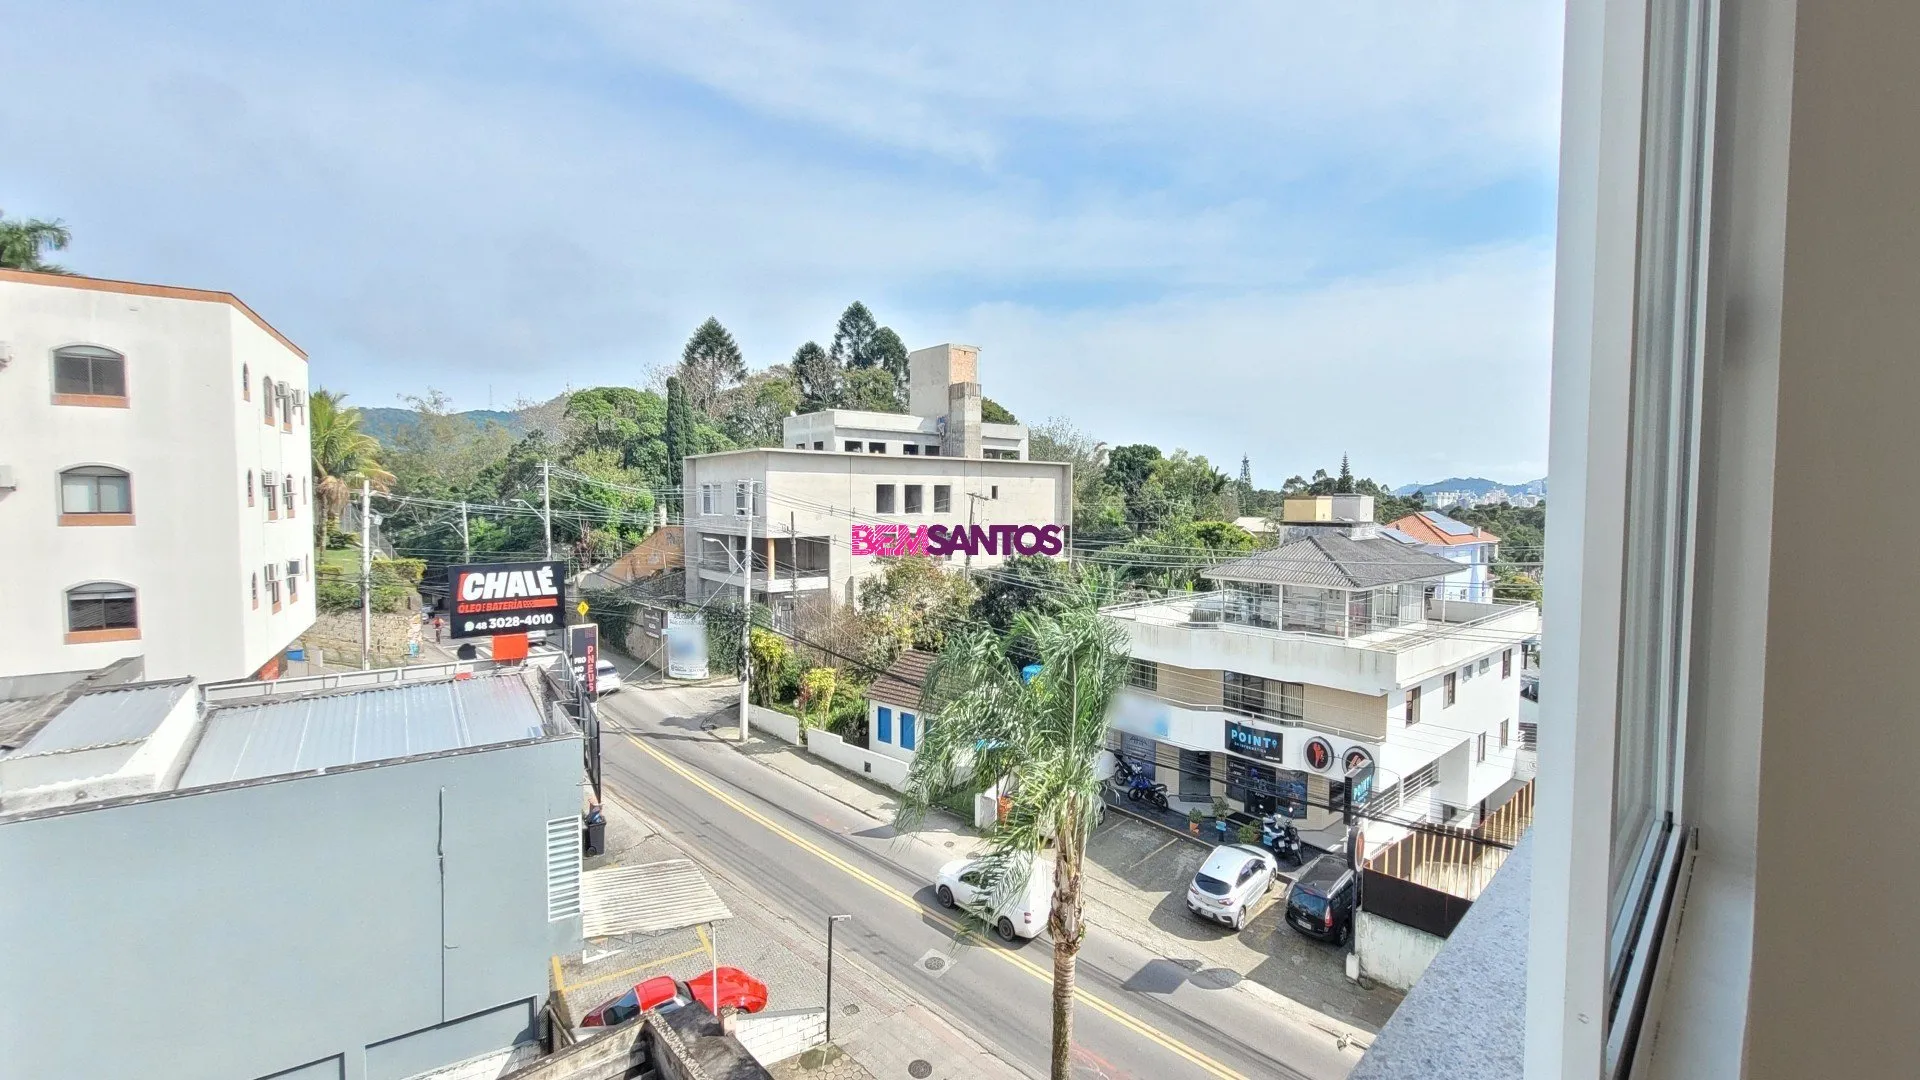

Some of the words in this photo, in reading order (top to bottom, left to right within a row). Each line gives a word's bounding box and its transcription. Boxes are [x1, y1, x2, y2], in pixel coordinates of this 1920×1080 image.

[462, 566, 558, 601] CHALÉ
[457, 602, 482, 614] ÓLEO
[475, 622, 487, 630] 48
[488, 614, 554, 629] 3028-4010
[587, 645, 595, 692] PNEUS
[1231, 729, 1271, 749] POINT
